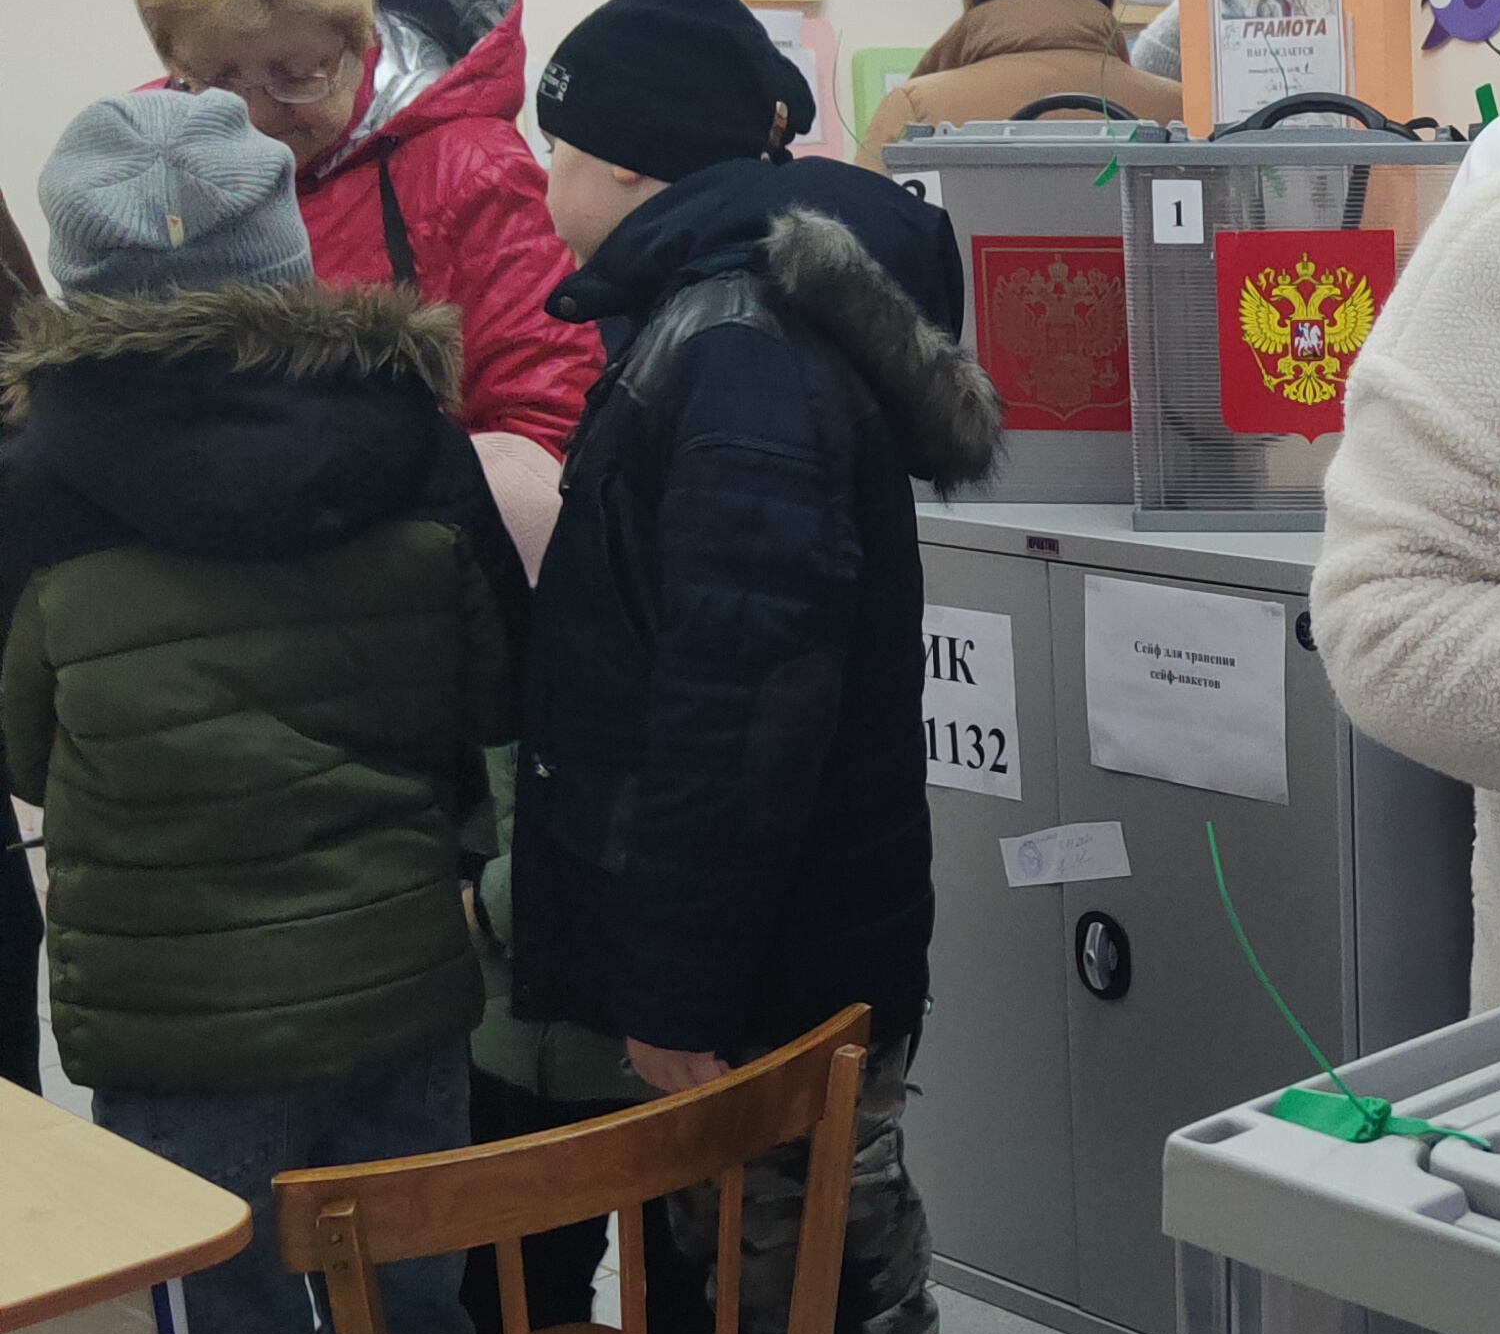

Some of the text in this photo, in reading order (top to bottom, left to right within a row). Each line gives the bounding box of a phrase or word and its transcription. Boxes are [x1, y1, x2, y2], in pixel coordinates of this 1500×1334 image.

[1242, 18, 1327, 39] ГРАМОТА
[1171, 199, 1185, 227] 1
[1134, 640, 1236, 667] Сейф для хранения
[1150, 668, 1221, 689] сейф-пакетов
[923, 716, 1009, 774] 1132
